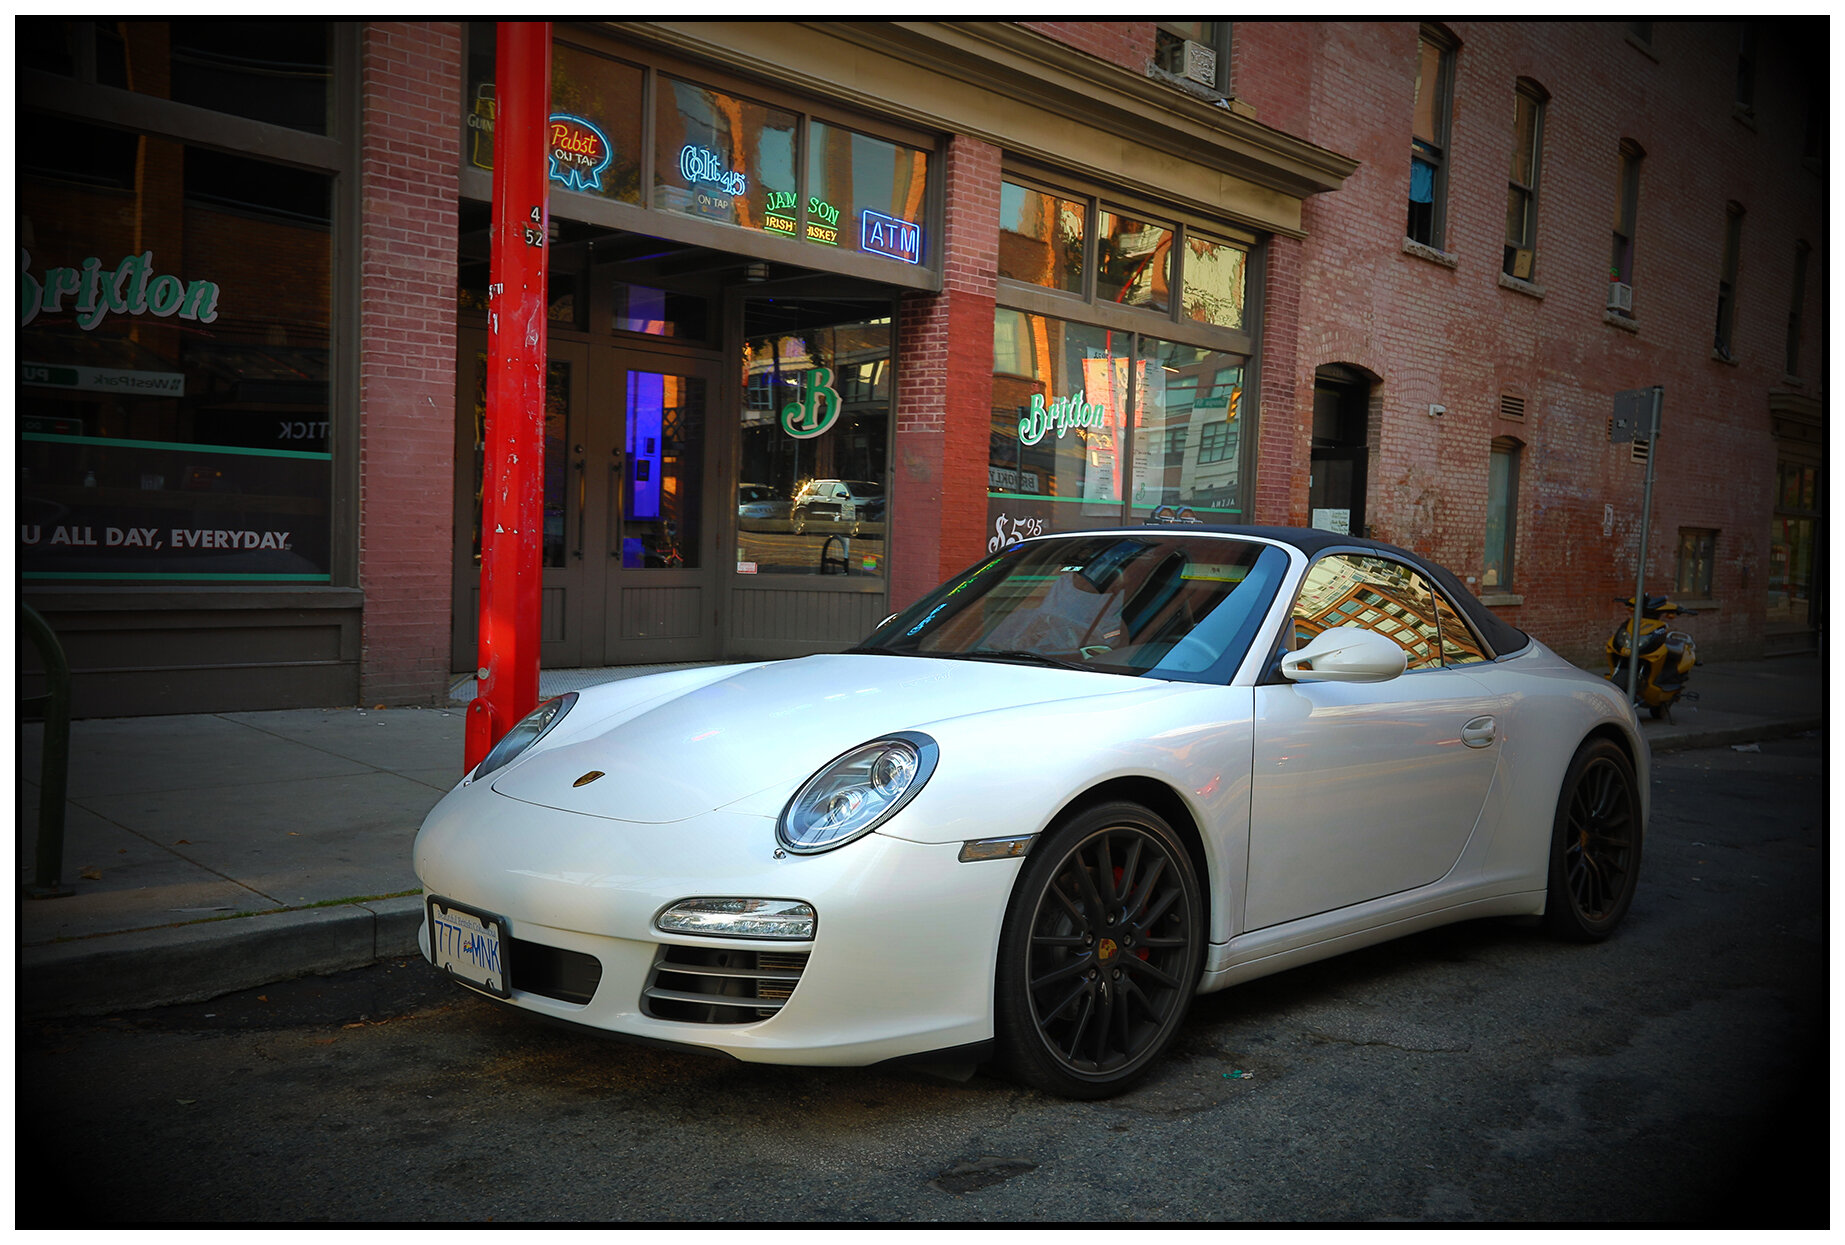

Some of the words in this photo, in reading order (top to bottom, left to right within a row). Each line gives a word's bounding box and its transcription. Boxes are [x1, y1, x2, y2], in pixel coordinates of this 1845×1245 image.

[467, 113, 495, 132] GUIN
[551, 124, 598, 154] Pabst
[555, 148, 572, 162] ON
[575, 153, 598, 166] TAP
[680, 145, 721, 182] Colt
[720, 171, 746, 195] 45
[530, 206, 541, 222] 4
[698, 194, 711, 206] ON
[713, 197, 729, 209] TAP
[766, 191, 840, 226] JAMSON
[525, 229, 543, 247] 52
[766, 217, 793, 232] IRISH
[870, 221, 916, 254] ATM
[22, 247, 220, 331] rixton
[781, 367, 843, 440] B
[1018, 389, 1105, 446] Brixton
[50, 526, 98, 547] ALL
[105, 527, 164, 550] DAY,
[171, 529, 291, 550] EVERYDAY
[435, 920, 462, 959] 777
[471, 933, 502, 975] MNK
